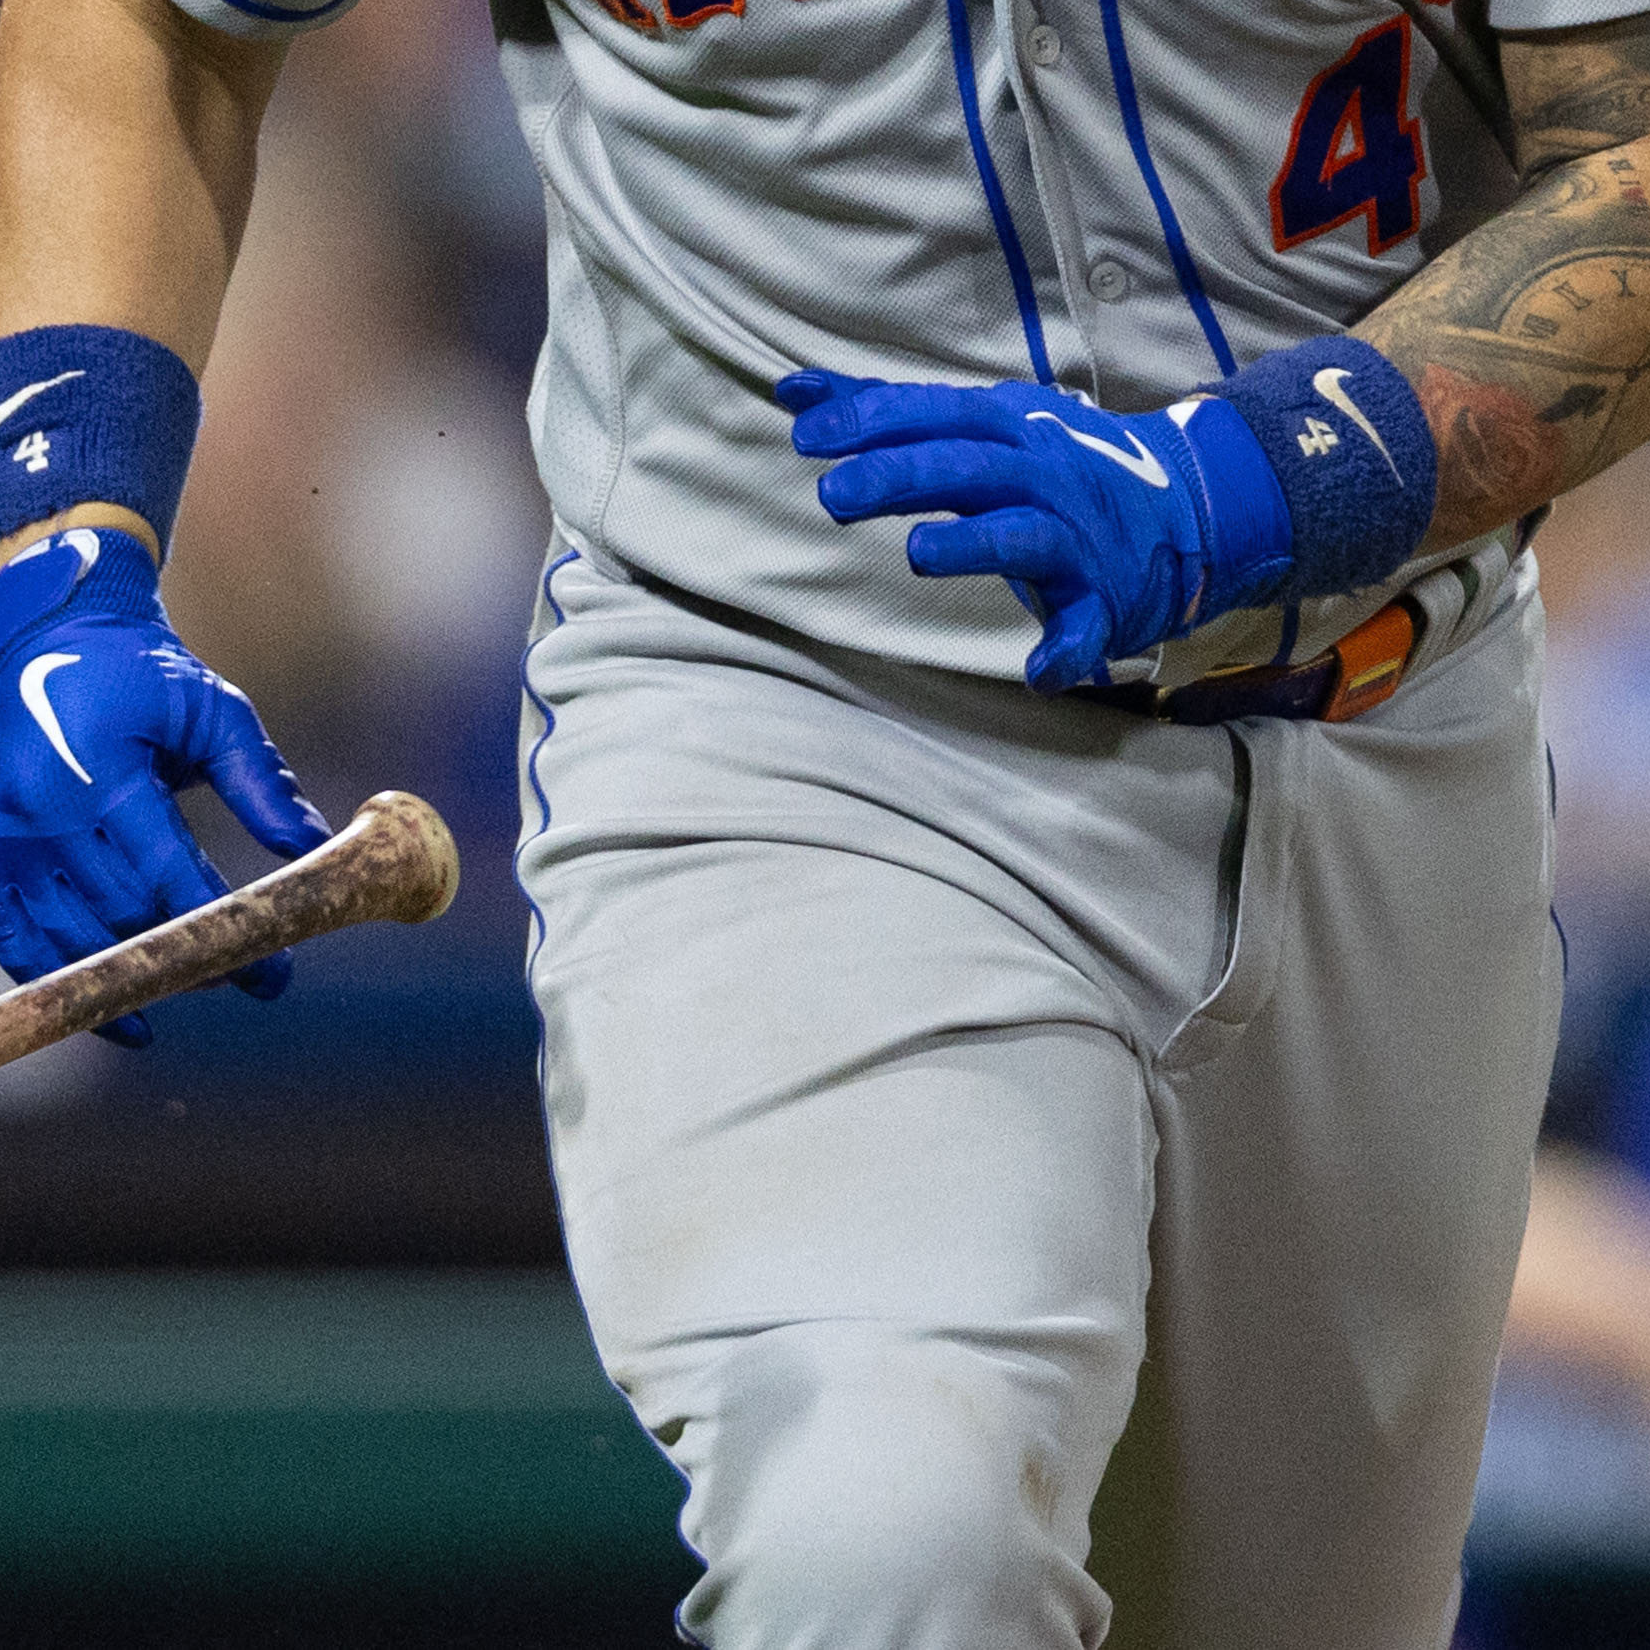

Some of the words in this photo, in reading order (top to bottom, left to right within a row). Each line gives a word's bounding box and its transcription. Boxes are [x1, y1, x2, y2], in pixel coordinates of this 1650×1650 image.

[1268, 13, 1427, 257] 4
[13, 430, 50, 473] 4
[1296, 416, 1339, 457] 4
